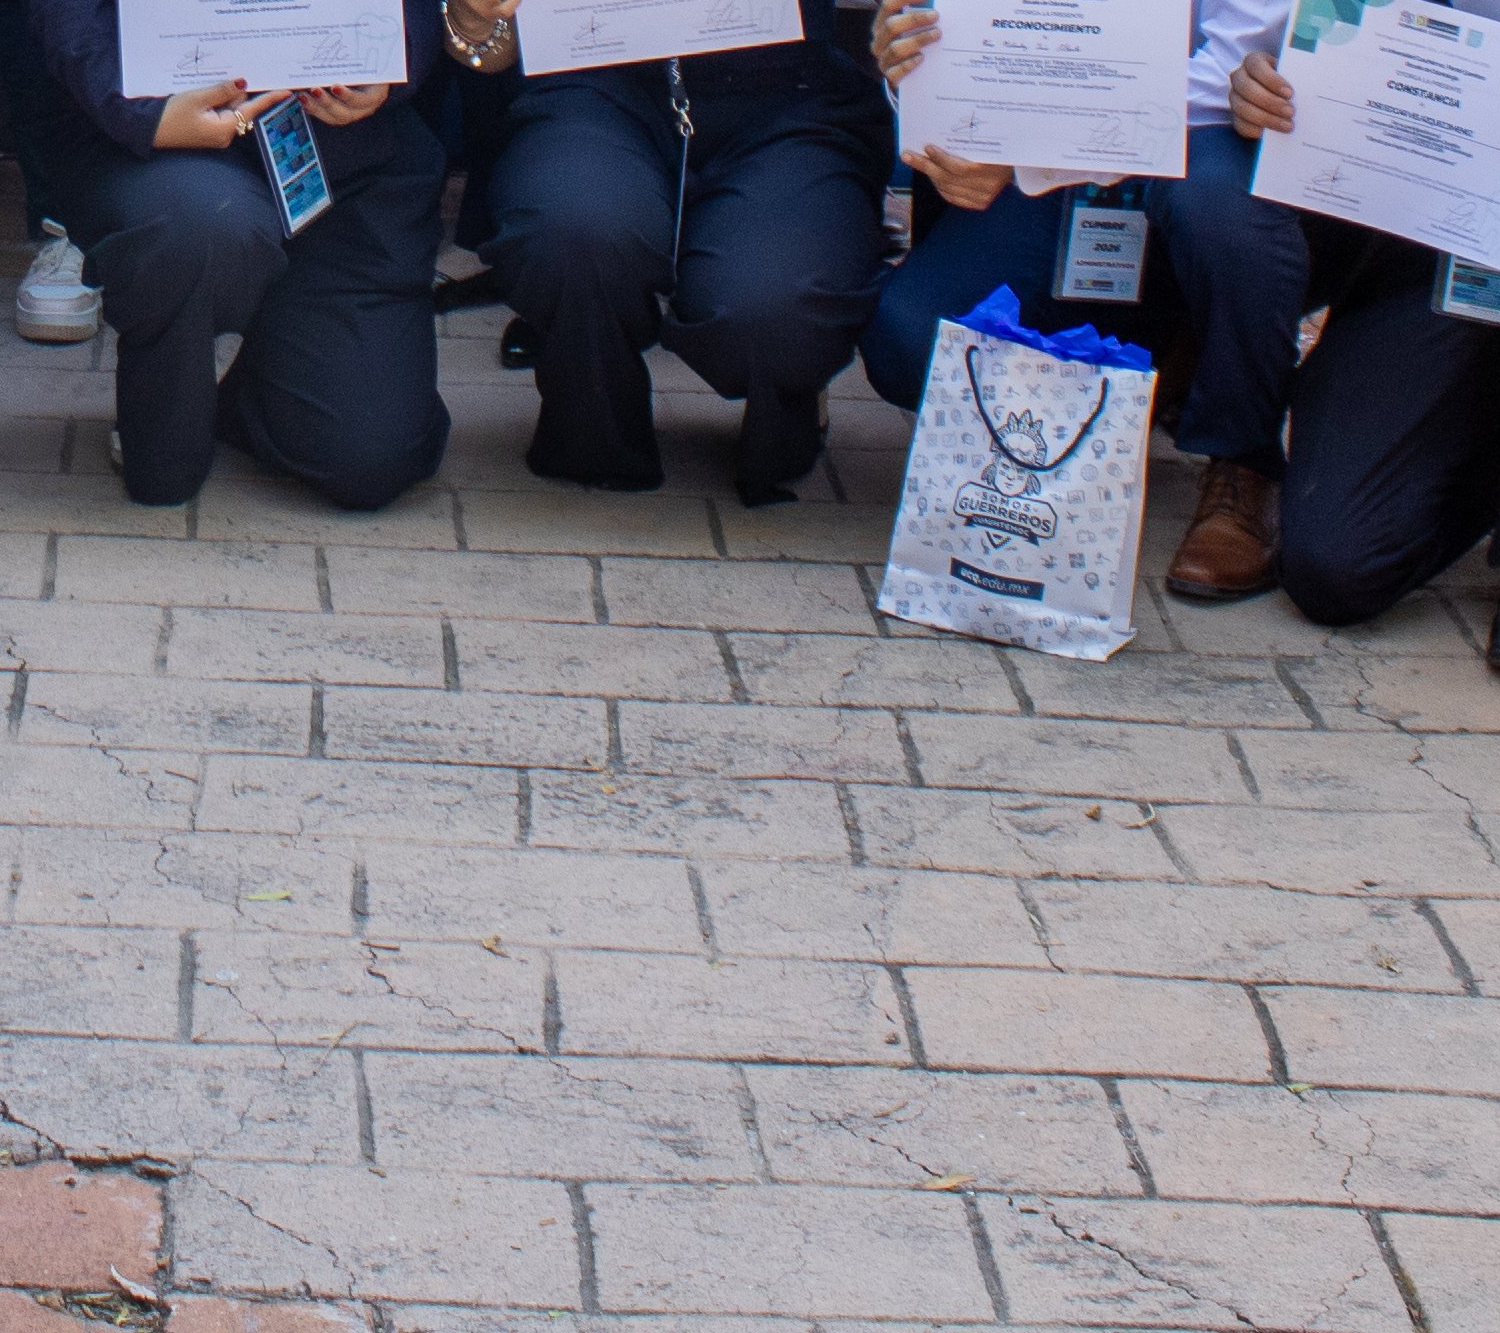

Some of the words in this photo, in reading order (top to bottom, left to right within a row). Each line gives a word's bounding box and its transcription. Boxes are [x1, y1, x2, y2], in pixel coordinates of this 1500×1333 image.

[992, 18, 1102, 35] RECONOCIMIENTO
[1386, 79, 1461, 109] CONSTANCIA
[959, 496, 1051, 532] GUERREROS
[983, 492, 1031, 512] SOMOS
